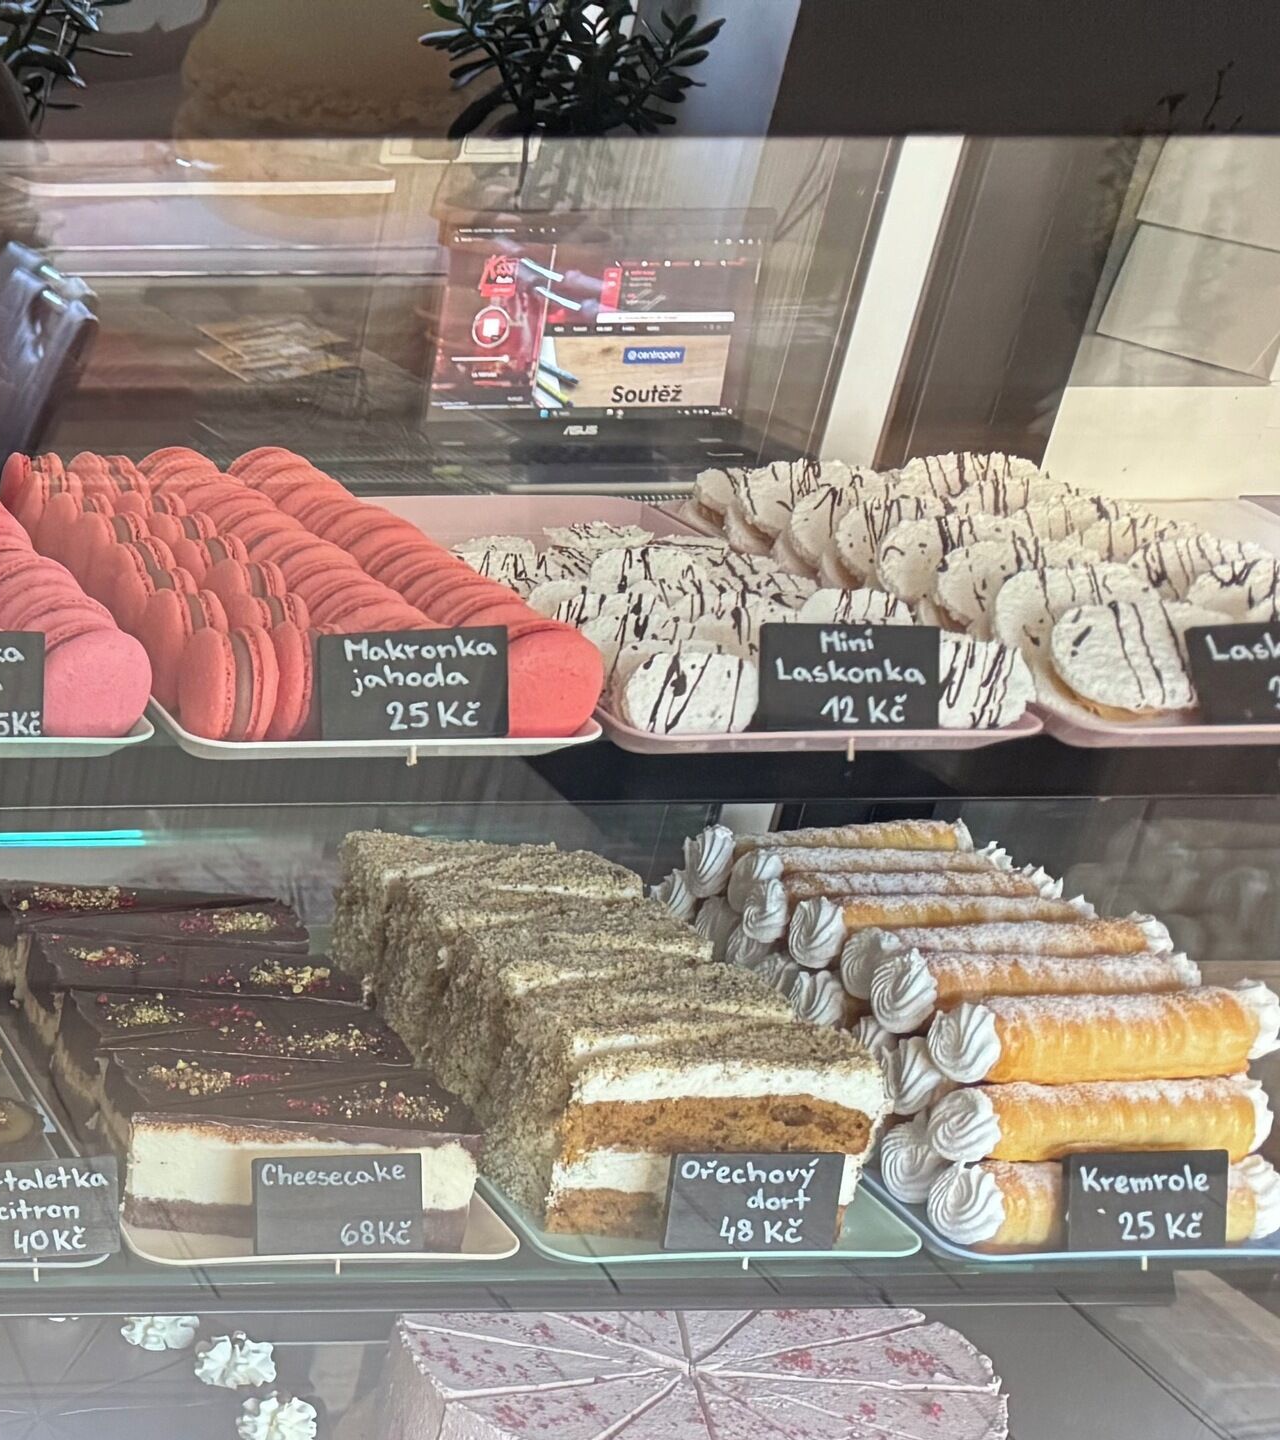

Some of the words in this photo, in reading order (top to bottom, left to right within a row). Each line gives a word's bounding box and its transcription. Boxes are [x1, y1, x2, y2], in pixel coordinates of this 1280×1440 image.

[610, 383, 683, 404] Soutěž
[562, 424, 599, 436] ASUS
[343, 634, 498, 662] Makronka
[819, 627, 875, 654] Mini
[350, 662, 470, 698] jahoda
[775, 656, 927, 686] Laskonka
[385, 700, 430, 731] 25
[436, 700, 481, 729] Kč
[820, 695, 860, 724] 12
[867, 693, 908, 725] Kč
[260, 1160, 407, 1187] Cheesecake
[680, 1157, 821, 1190] Ořechový
[1078, 1163, 1211, 1195] Kremrole
[746, 1187, 812, 1211] dort
[13, 1228, 50, 1255] 40
[51, 1225, 88, 1252] Kč
[719, 1215, 755, 1245] 48
[763, 1217, 804, 1245] Kč
[1117, 1210, 1156, 1241] 25
[1164, 1211, 1204, 1241] Kč
